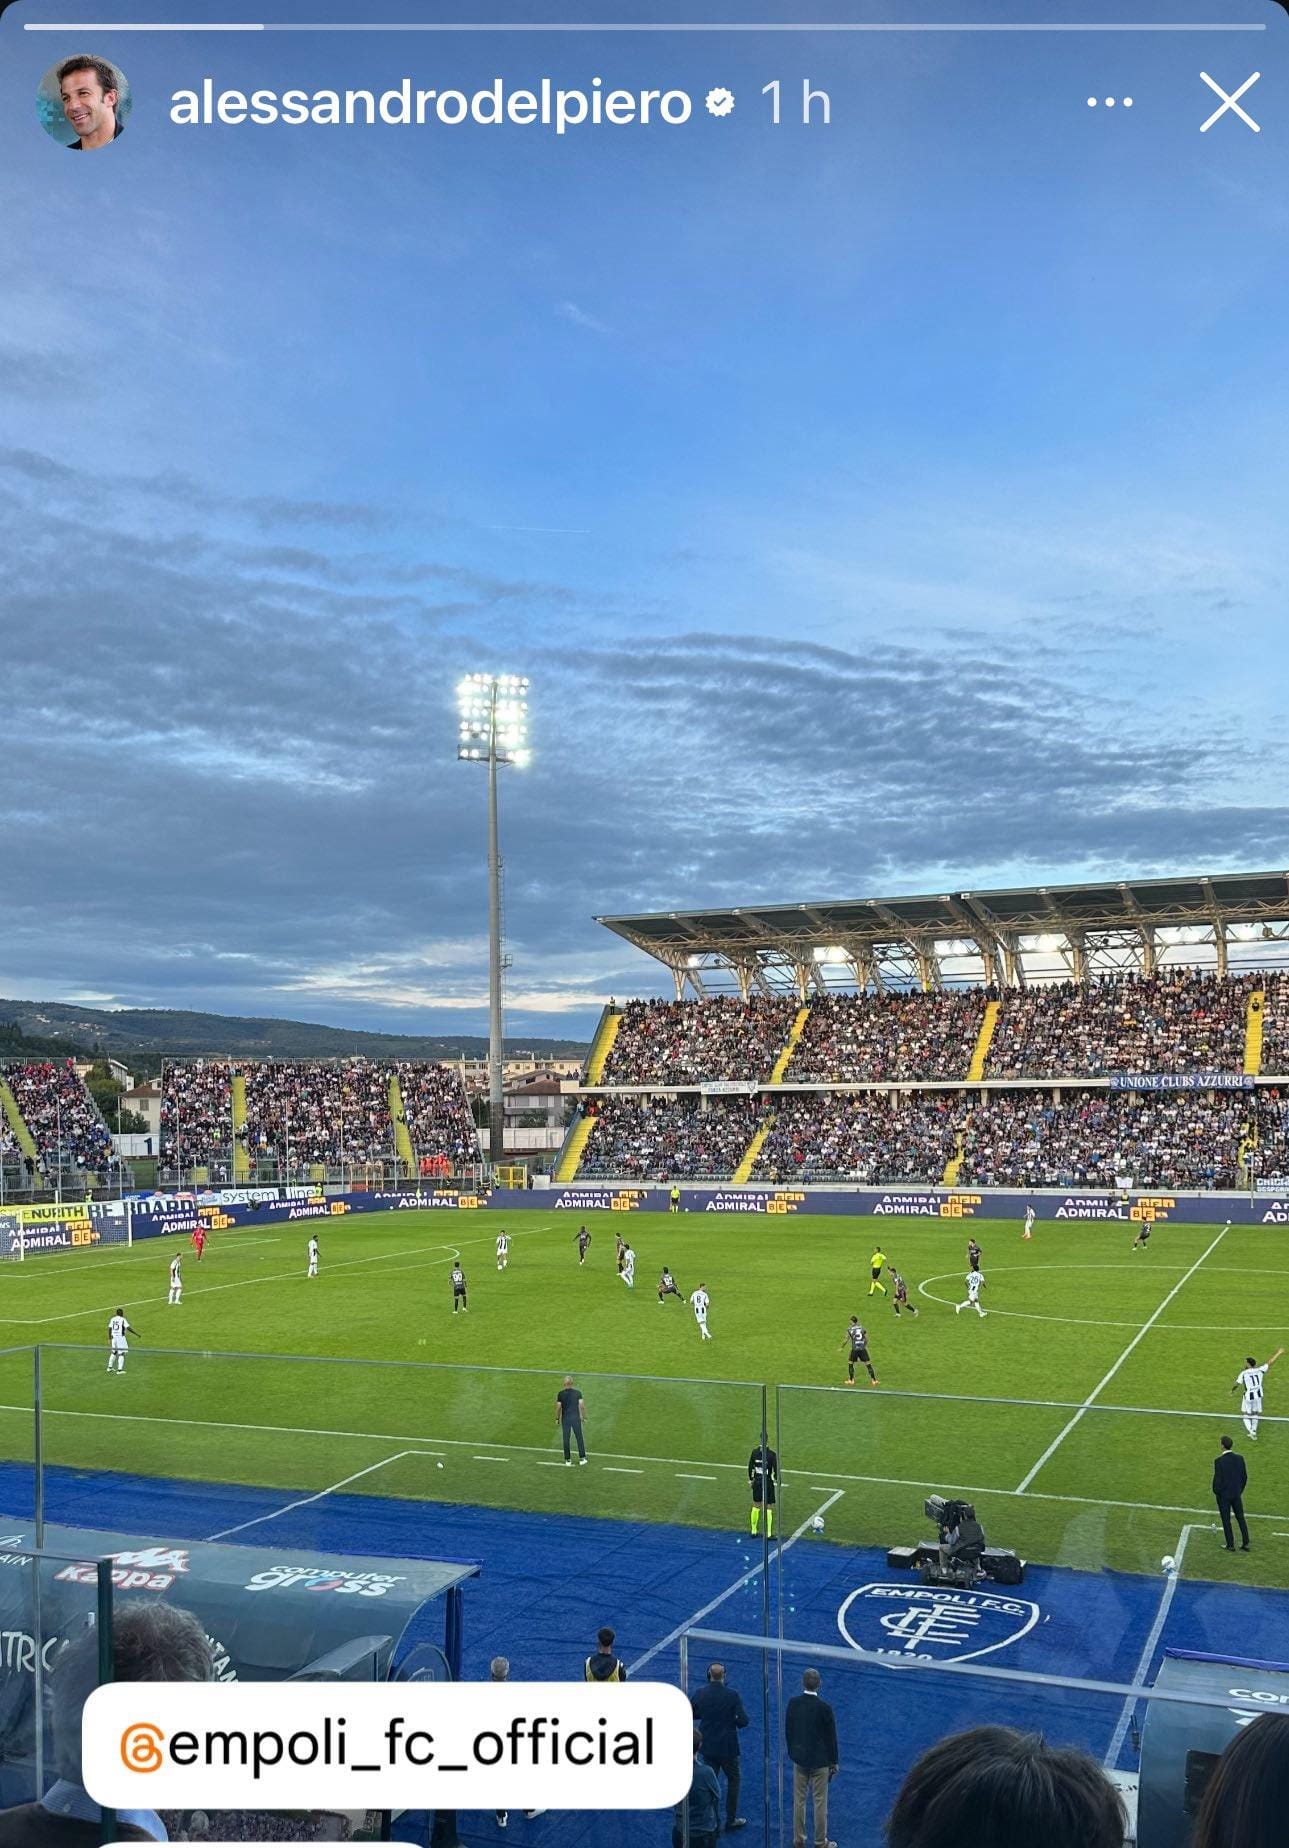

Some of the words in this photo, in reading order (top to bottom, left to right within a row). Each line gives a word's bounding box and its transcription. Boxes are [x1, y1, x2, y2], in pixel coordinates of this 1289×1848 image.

[1120, 1076, 1158, 1088] UNIONE
[1160, 1076, 1195, 1087] CLUBS
[1197, 1075, 1243, 1087] AZZURRI
[222, 1189, 276, 1204] system
[398, 1198, 458, 1208] ADMIRAL
[555, 1199, 610, 1209] ADMIRAL
[706, 1201, 766, 1212] ADMIRAL
[873, 1204, 939, 1216] ADMIRAL
[288, 1205, 330, 1219] ADMIRAL
[1055, 1207, 1129, 1220] ADMIRAL
[1262, 1210, 1289, 1223] AD
[161, 1218, 211, 1234] ADMIRAL
[11, 1233, 71, 1251] ADMIRAL
[1250, 1374, 1260, 1387] 11
[269, 1565, 408, 1584] computer
[244, 1571, 396, 1597] gross
[870, 1587, 977, 1606] EMPOLI
[980, 1599, 1026, 1615] F.C.
